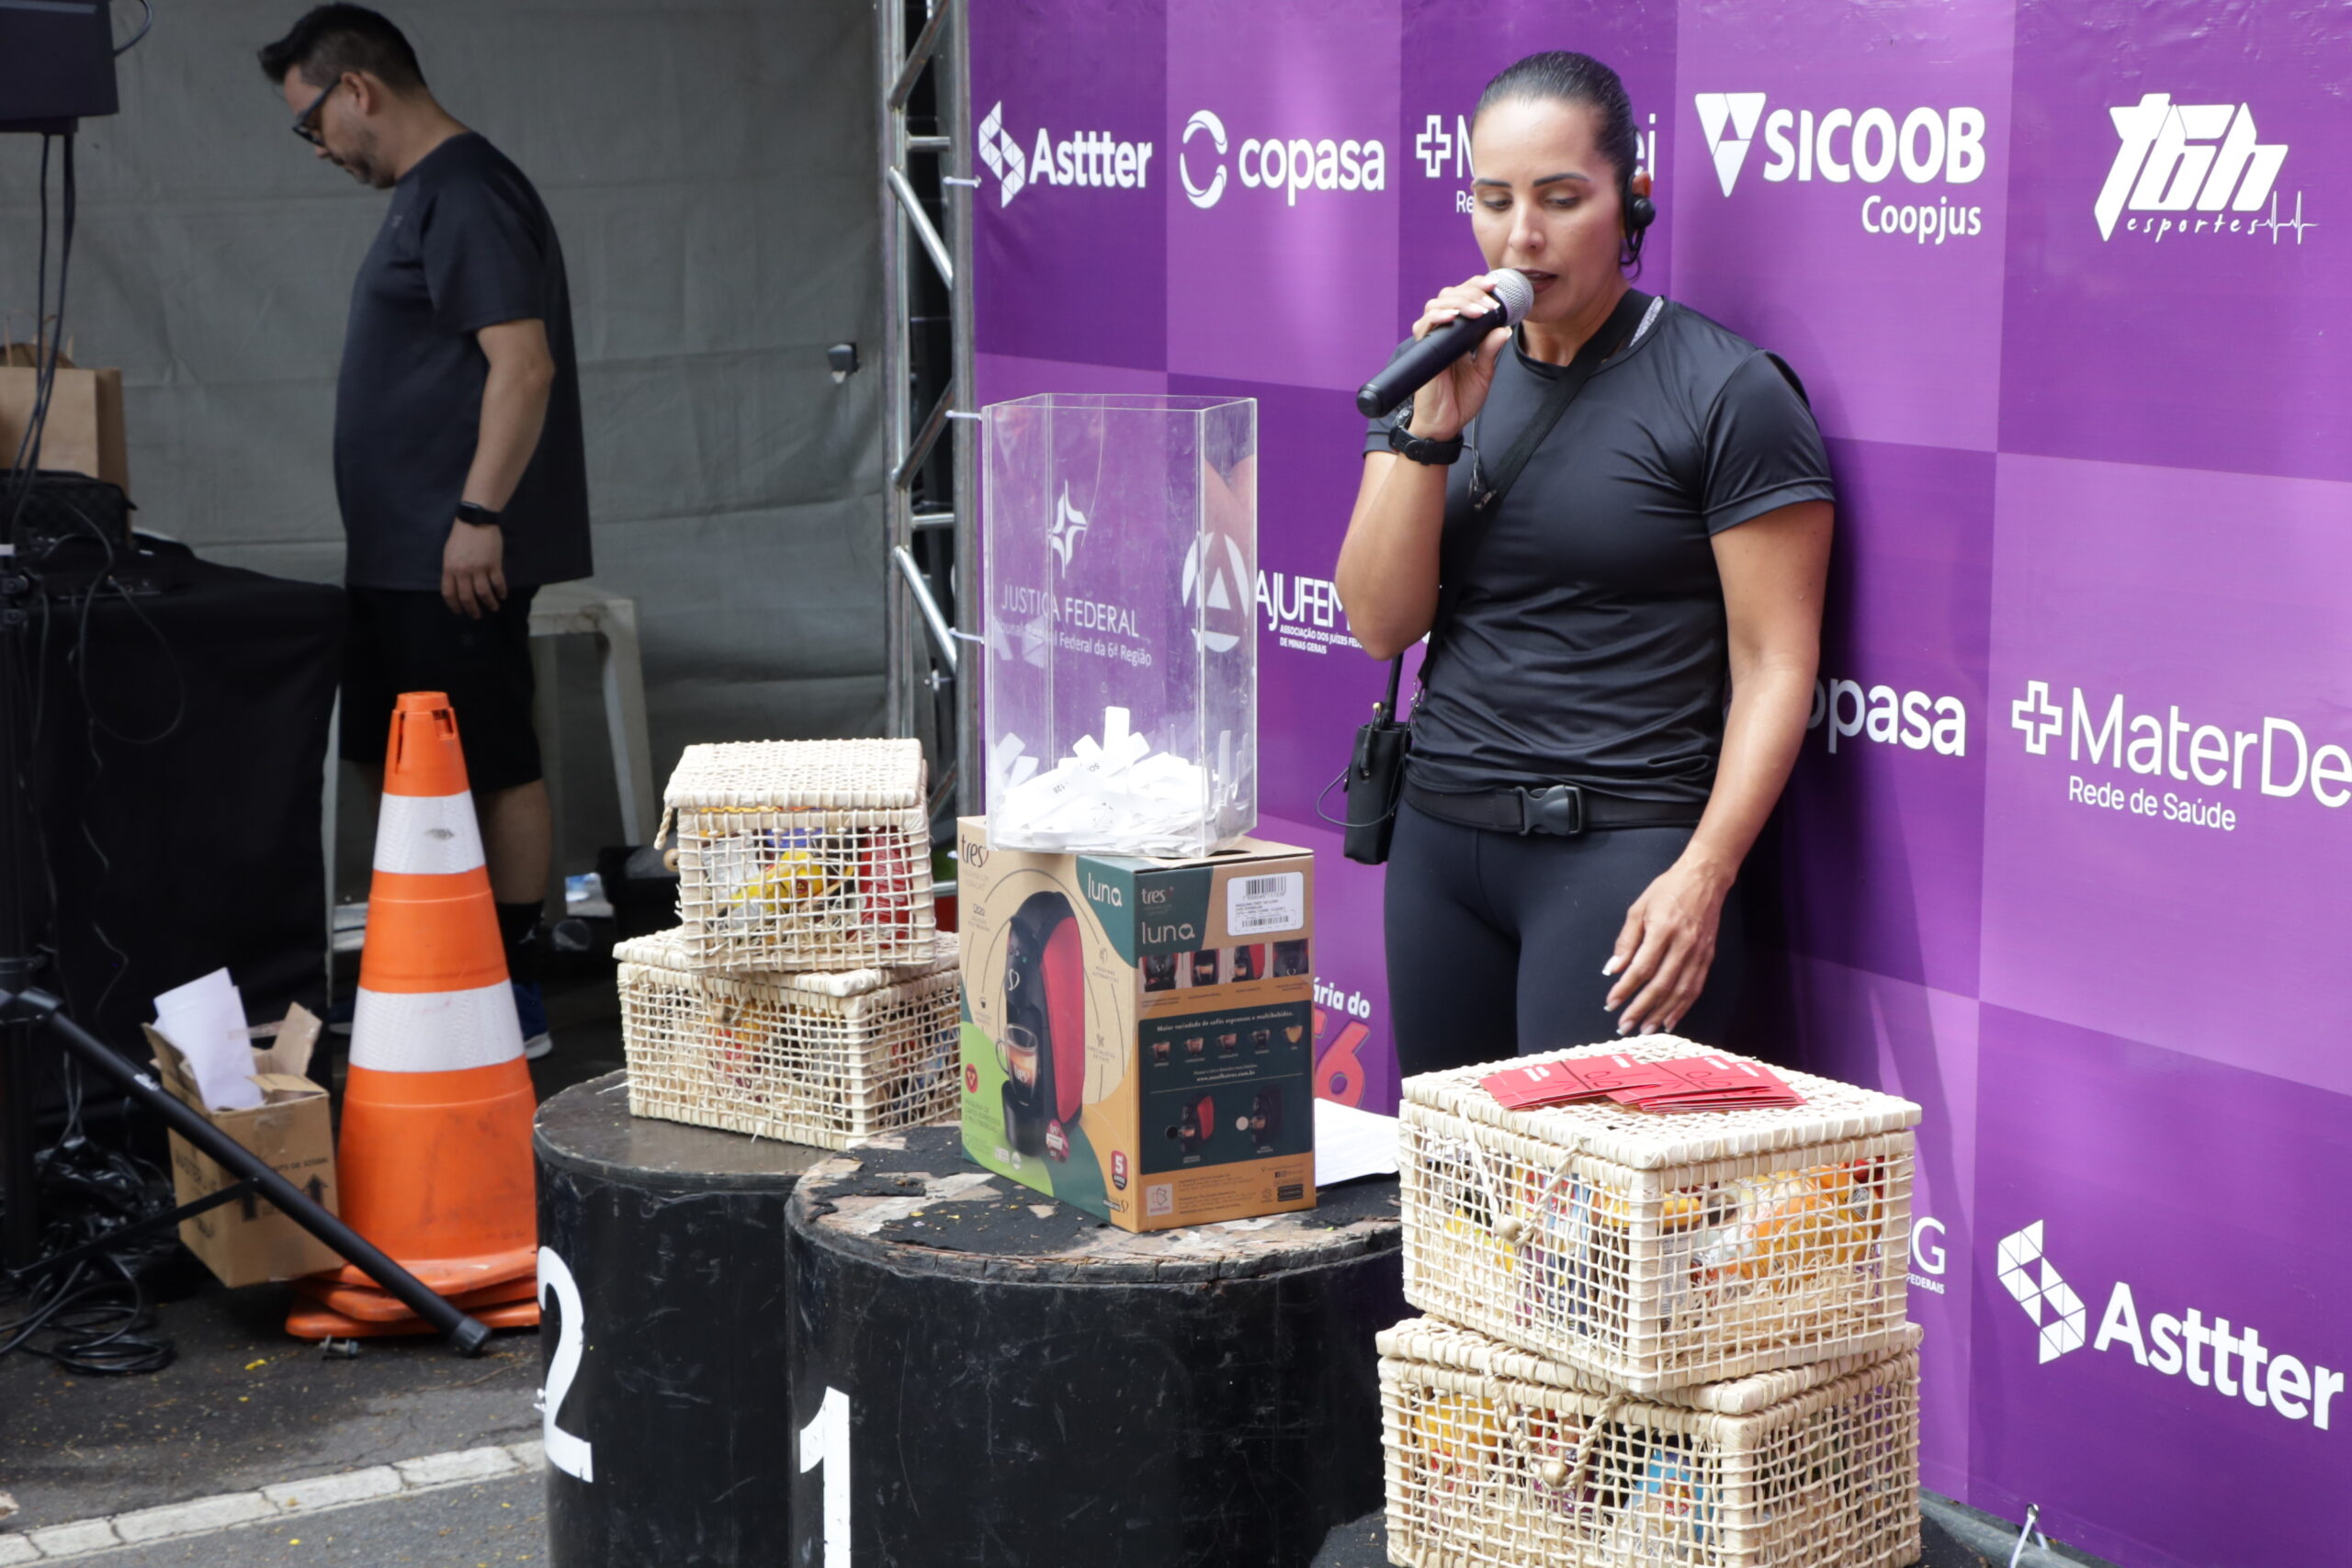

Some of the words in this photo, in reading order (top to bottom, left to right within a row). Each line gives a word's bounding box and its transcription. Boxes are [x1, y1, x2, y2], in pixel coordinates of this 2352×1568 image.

[1029, 128, 1153, 186] Asttter
[1763, 106, 1986, 184] SICOOB
[1238, 137, 1385, 207] copasa
[1455, 190, 1474, 214] Re
[1861, 195, 1983, 244] Coopjus
[2127, 215, 2260, 243] esportes
[1065, 596, 1140, 638] FEDERAL
[1279, 624, 1317, 640] ASSOCIAÇÃO
[1317, 631, 1329, 643] DOS
[1329, 632, 1348, 645] JUÍZES
[1059, 631, 1092, 654] Federal
[1093, 641, 1107, 658] da
[1120, 645, 1152, 668] Região
[1279, 637, 1288, 647] DE
[1288, 637, 1306, 651] MINAS
[1306, 642, 1327, 654] GERAIS
[1806, 678, 1966, 756] opasa
[2068, 774, 2125, 811] Rede
[2129, 788, 2159, 817] de
[2163, 792, 2237, 831] Saúde
[961, 834, 988, 868] tres
[1087, 872, 1123, 908] luna
[1141, 887, 1167, 905] tres
[1141, 921, 1196, 945] luna
[1347, 991, 1371, 1019] do
[1114, 1155, 1125, 1175] 5
[537, 1246, 594, 1483] 2
[2093, 1281, 2344, 1431] Asttter
[799, 1385, 851, 1568] 1
